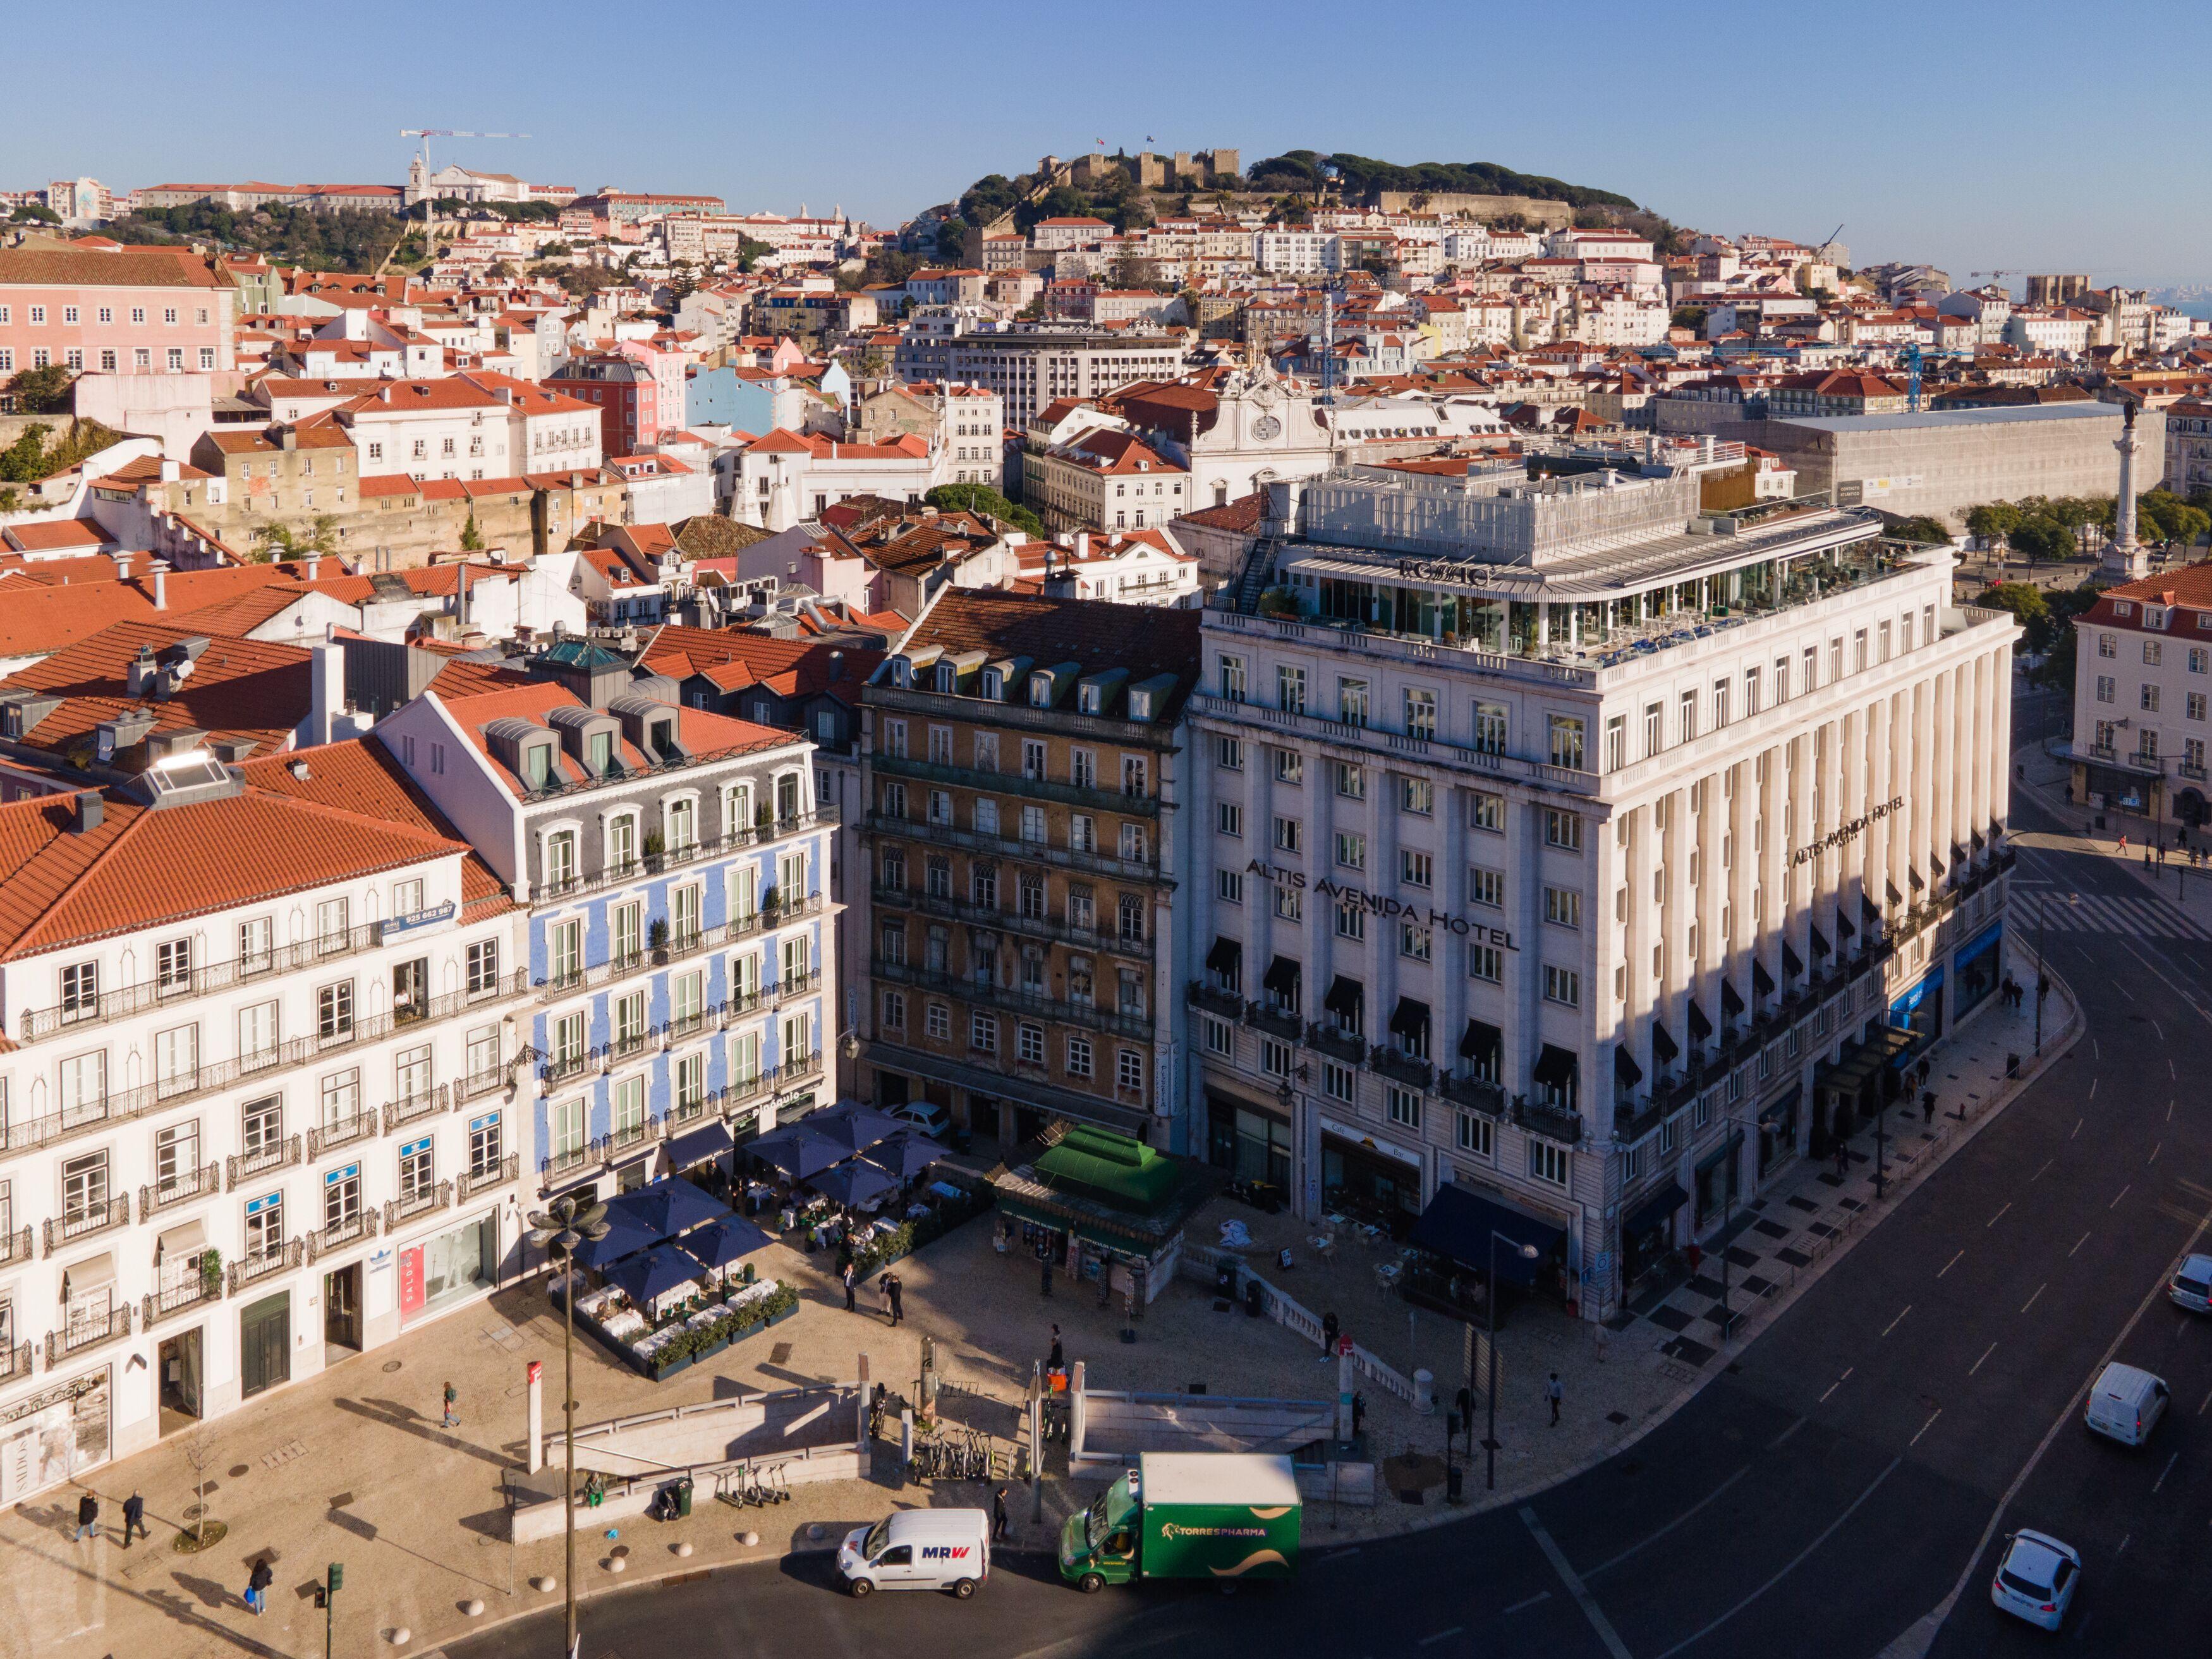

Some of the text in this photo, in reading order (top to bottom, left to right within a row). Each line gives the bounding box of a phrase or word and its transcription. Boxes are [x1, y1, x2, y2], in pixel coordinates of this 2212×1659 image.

[1792, 796, 1905, 868] ALTIS AVENIDA HOTEL
[406, 915, 421, 923] 925
[422, 910, 437, 919] 662
[1246, 858, 1520, 952] ALTIS AVENIDA HOTEL
[1332, 1124, 1404, 1158] Café Bar
[16, 1440, 27, 1492] SALDOS
[921, 1547, 971, 1559] MRW
